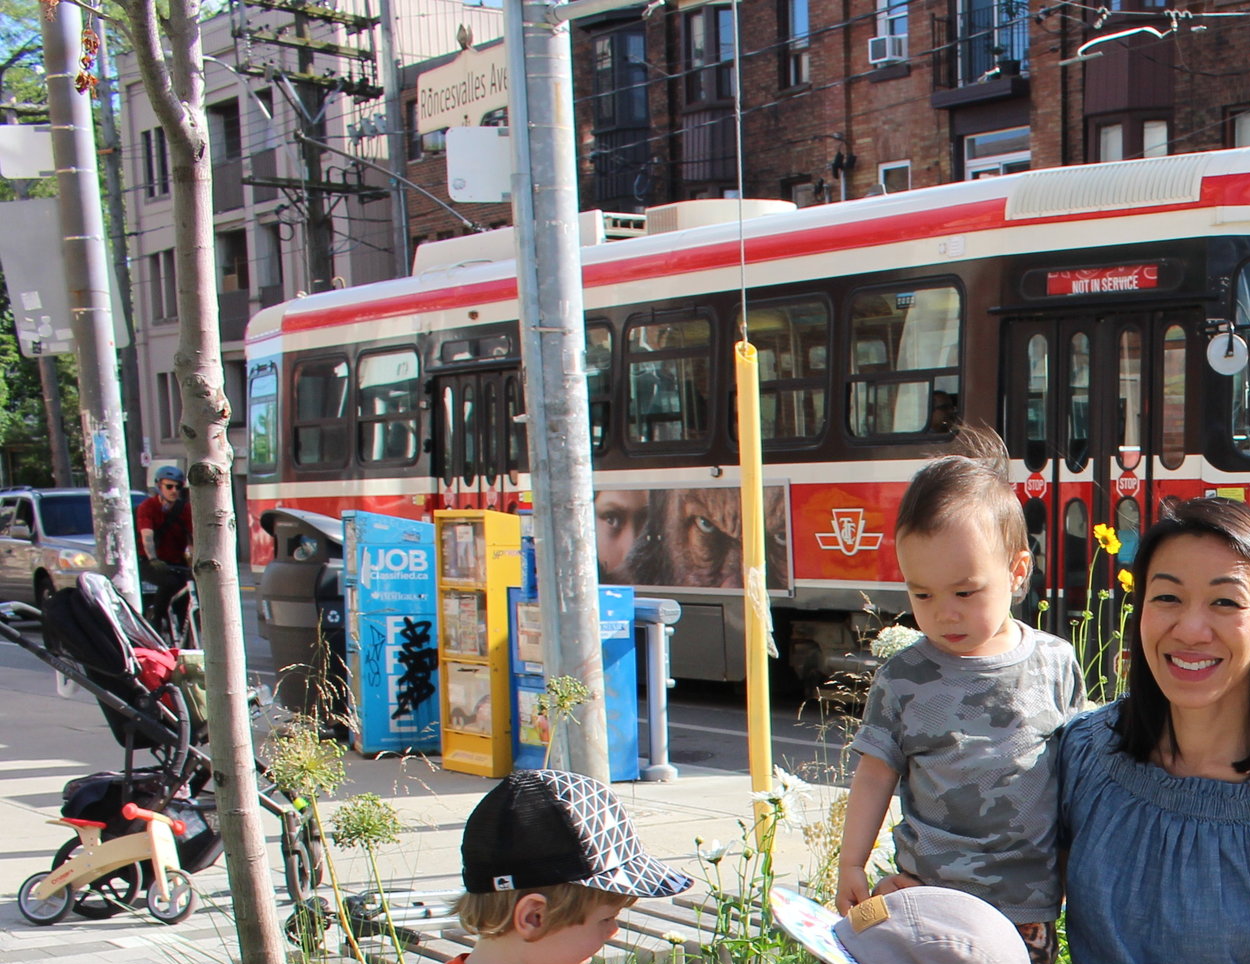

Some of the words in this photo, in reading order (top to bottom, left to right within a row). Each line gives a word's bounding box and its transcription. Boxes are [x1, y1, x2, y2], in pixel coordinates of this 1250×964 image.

[420, 72, 486, 120] Roncesvalles
[489, 63, 508, 96] Ave
[1071, 279, 1091, 295] NOT
[1091, 278, 1101, 293] IN
[1101, 275, 1139, 292] SERVICE
[1026, 479, 1044, 491] STOP
[1118, 477, 1137, 490] STOP
[369, 548, 429, 572] JOB
